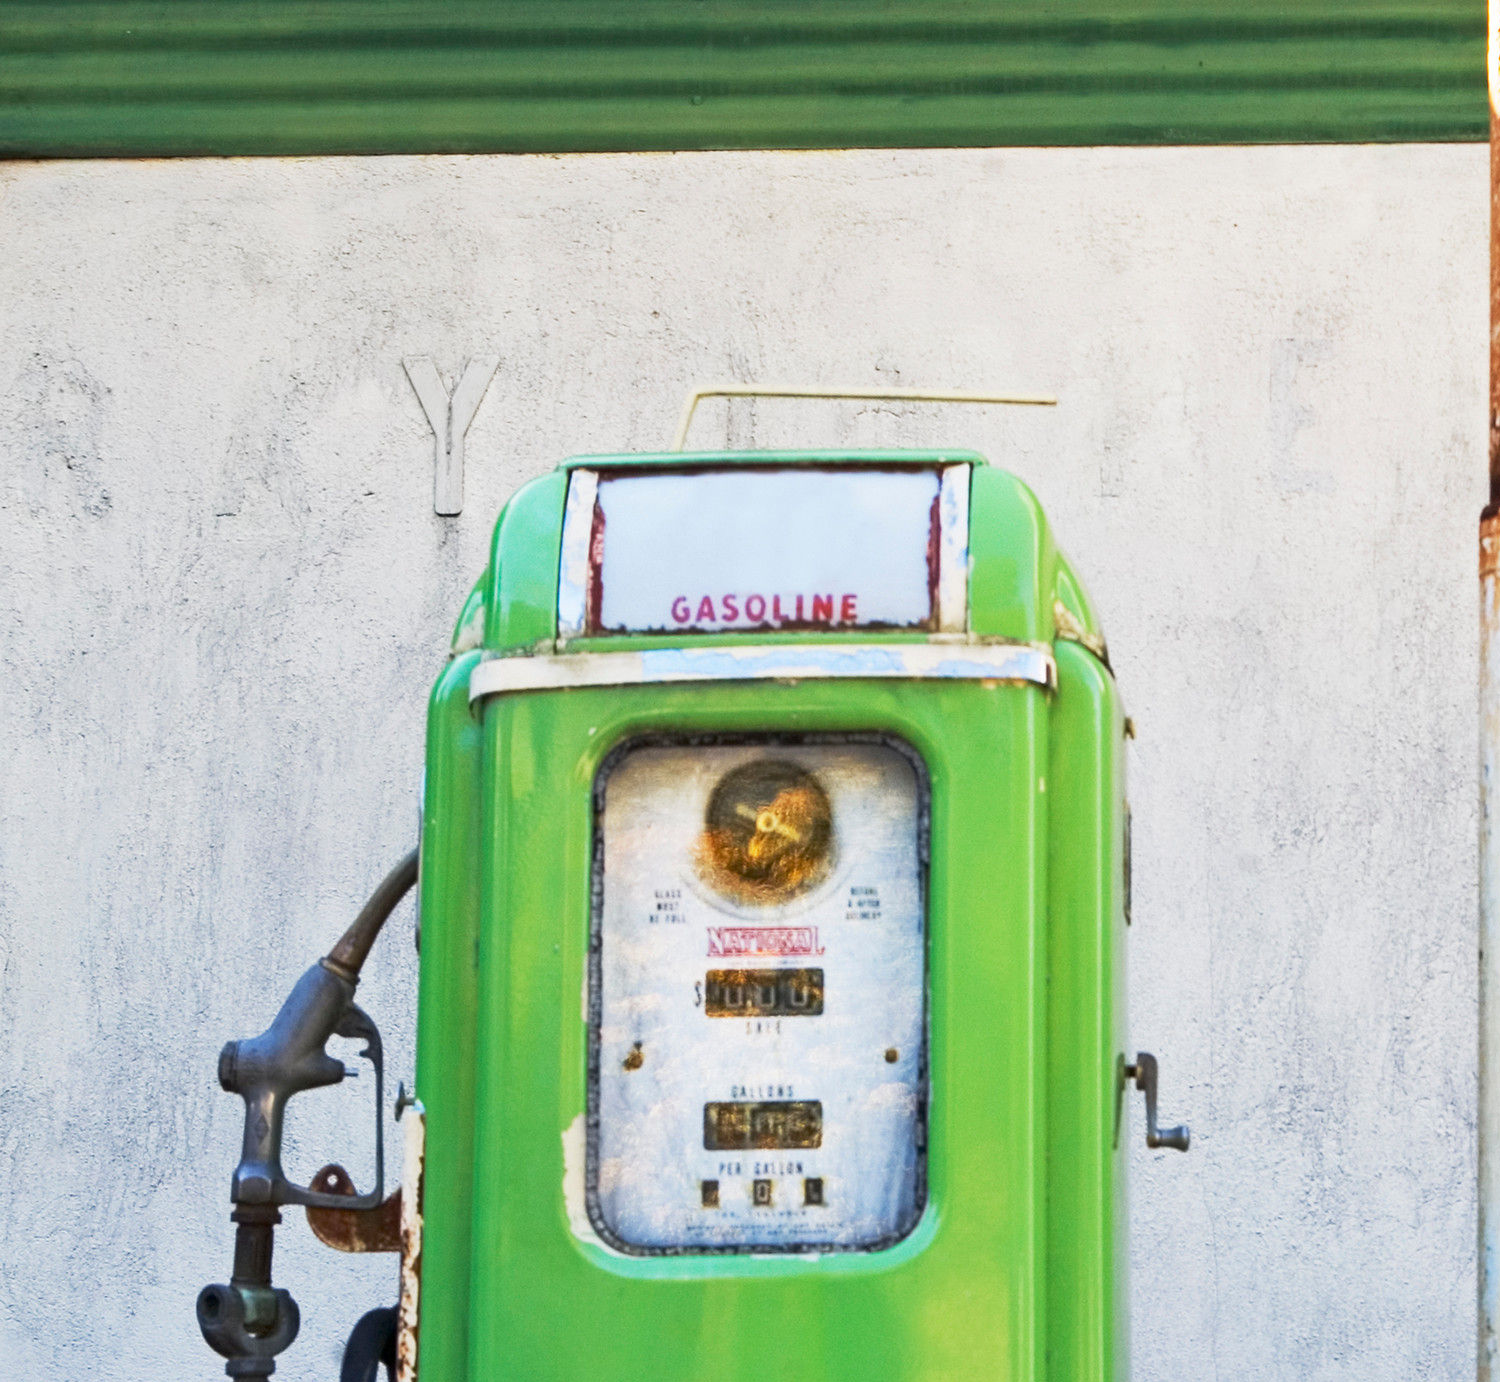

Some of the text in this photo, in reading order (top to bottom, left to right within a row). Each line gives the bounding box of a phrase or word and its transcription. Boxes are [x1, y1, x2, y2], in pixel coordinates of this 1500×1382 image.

[671, 593, 859, 625] GASOLINE
[730, 1085, 795, 1099] GALLONS
[718, 1161, 804, 1177] PER GALLON
